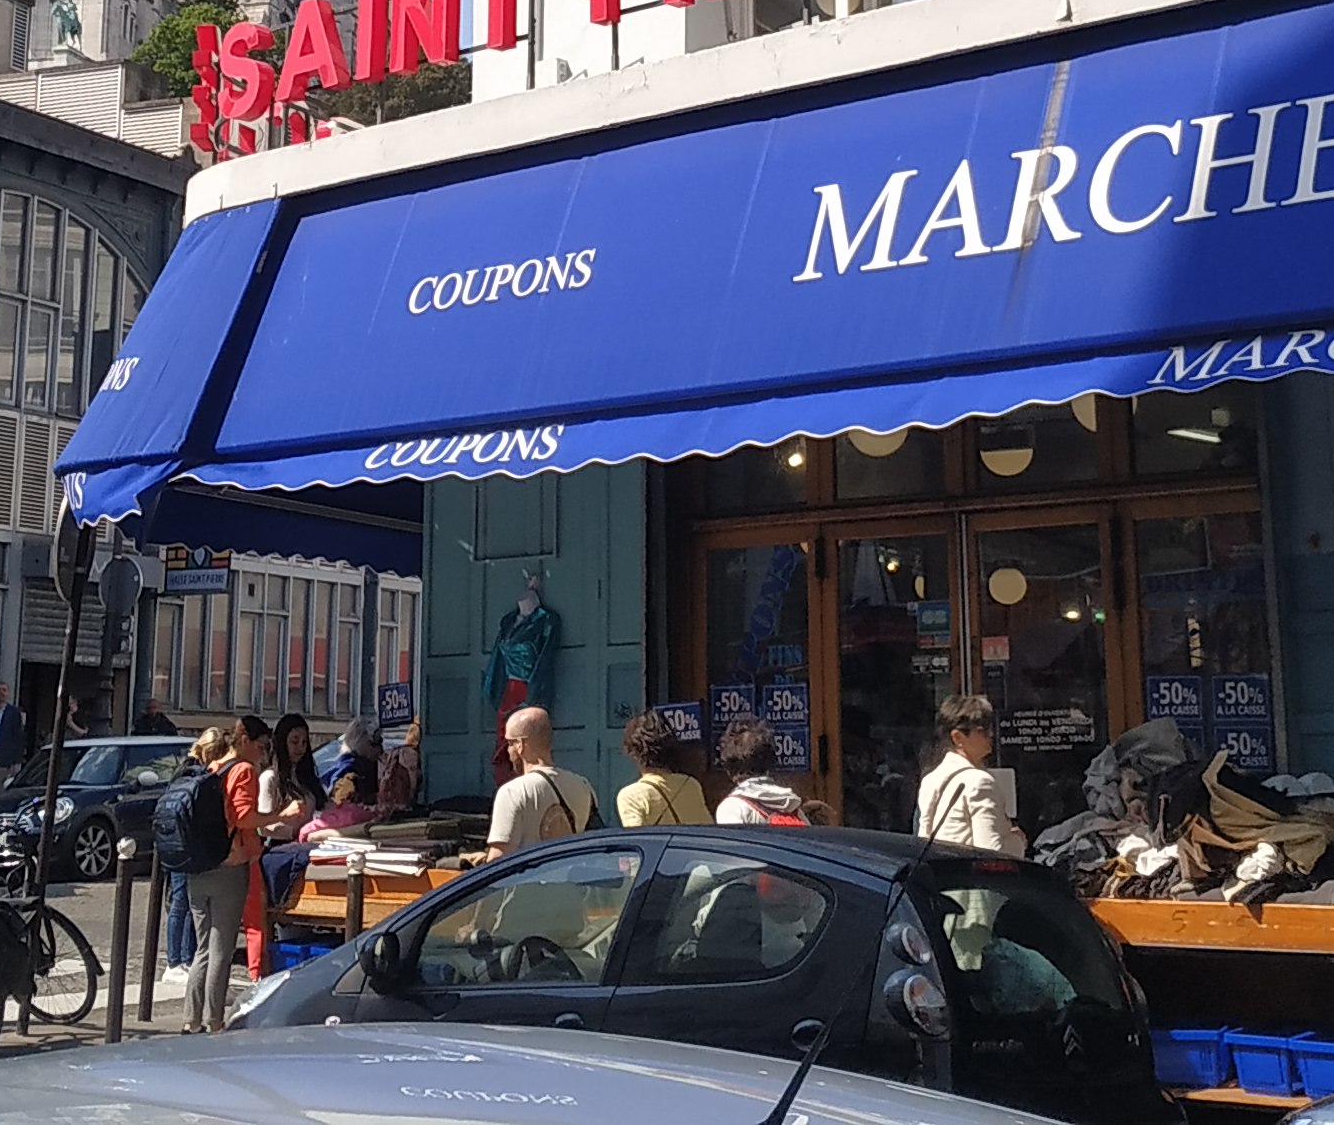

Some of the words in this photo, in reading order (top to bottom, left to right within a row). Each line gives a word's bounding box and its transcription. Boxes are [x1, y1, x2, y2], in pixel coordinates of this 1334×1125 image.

[408, 248, 596, 314] COUPONS
[364, 423, 565, 470] COUPONS
[382, 689, 408, 710] -50%
[715, 692, 750, 711] -50%
[767, 690, 803, 711] -50%
[1152, 682, 1197, 705] -50%
[1218, 681, 1264, 704] -50%
[772, 712, 783, 720] LA
[784, 711, 804, 721] CAISSE
[1158, 706, 1170, 715] LA
[1171, 705, 1199, 715] CAISSE
[1225, 705, 1236, 714] LA
[1237, 704, 1267, 714] CAISSE
[663, 709, 699, 732] 50%
[1012, 719, 1037, 727] LUNDI
[774, 736, 804, 756] 50%
[1000, 736, 1032, 744] SAMEDI
[1239, 756, 1268, 767] CAISSE
